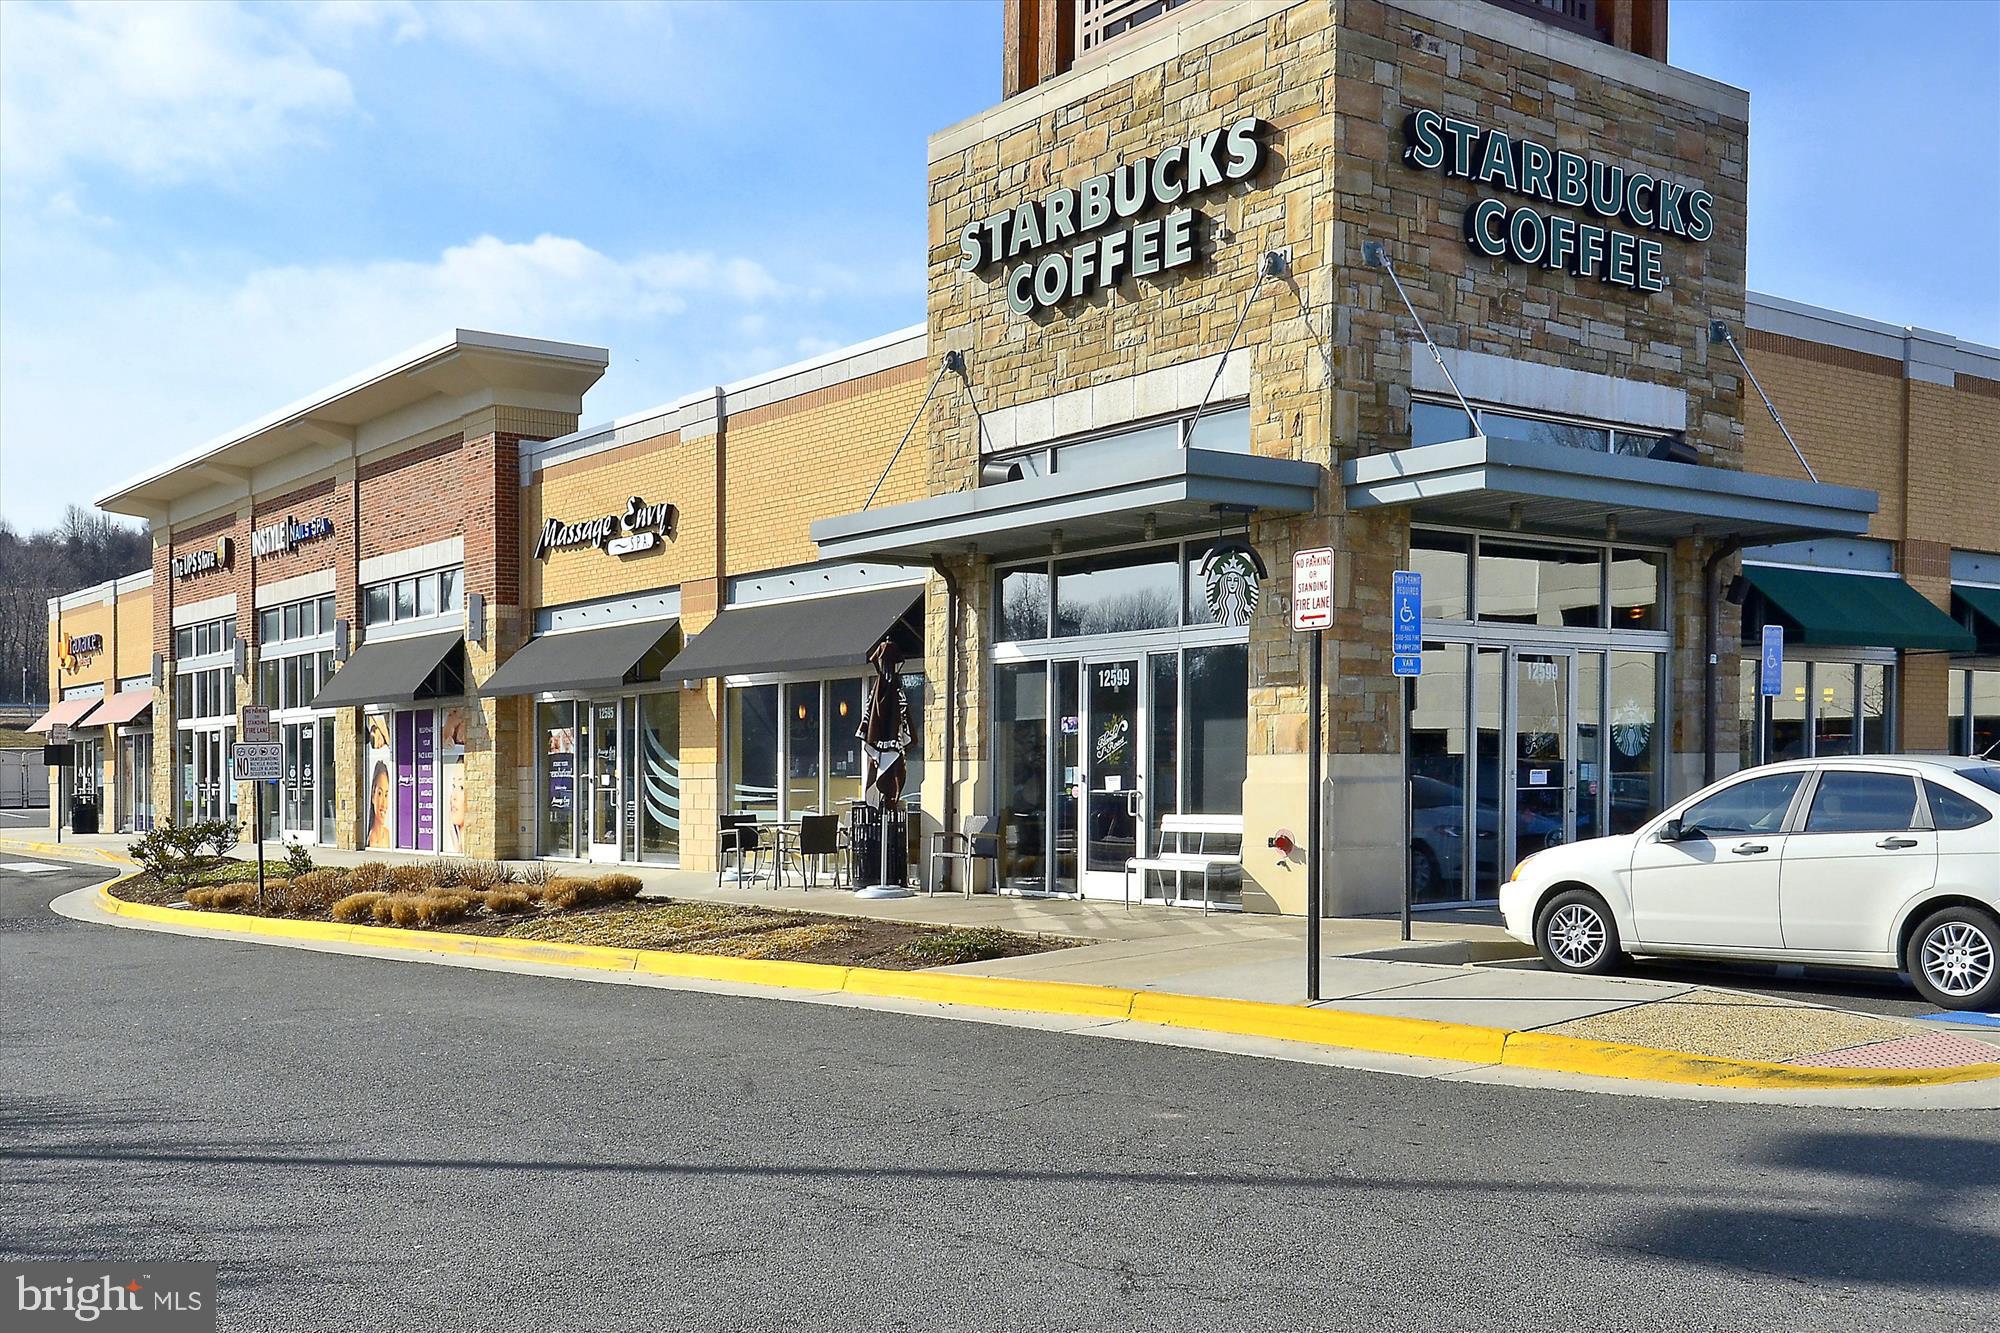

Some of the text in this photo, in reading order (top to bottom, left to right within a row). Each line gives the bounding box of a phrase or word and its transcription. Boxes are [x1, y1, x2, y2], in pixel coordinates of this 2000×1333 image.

[1413, 109, 1714, 242] STARBUCKS
[959, 117, 1258, 273] STARBUCKS
[1474, 198, 1663, 292] COFFEE
[1007, 207, 1193, 316] COFFEE
[251, 521, 285, 557] INSTYLE
[534, 496, 667, 559] Massage Envy
[172, 550, 215, 578] The UPS Store
[1296, 555, 1331, 569] NO PARKING
[1309, 570, 1317, 579] OR
[1298, 580, 1328, 594] STANDING
[1295, 596, 1330, 611] FIRE LANE
[1098, 668, 1130, 687] 12599
[1528, 662, 1558, 680] 12599
[237, 757, 249, 776] NO
